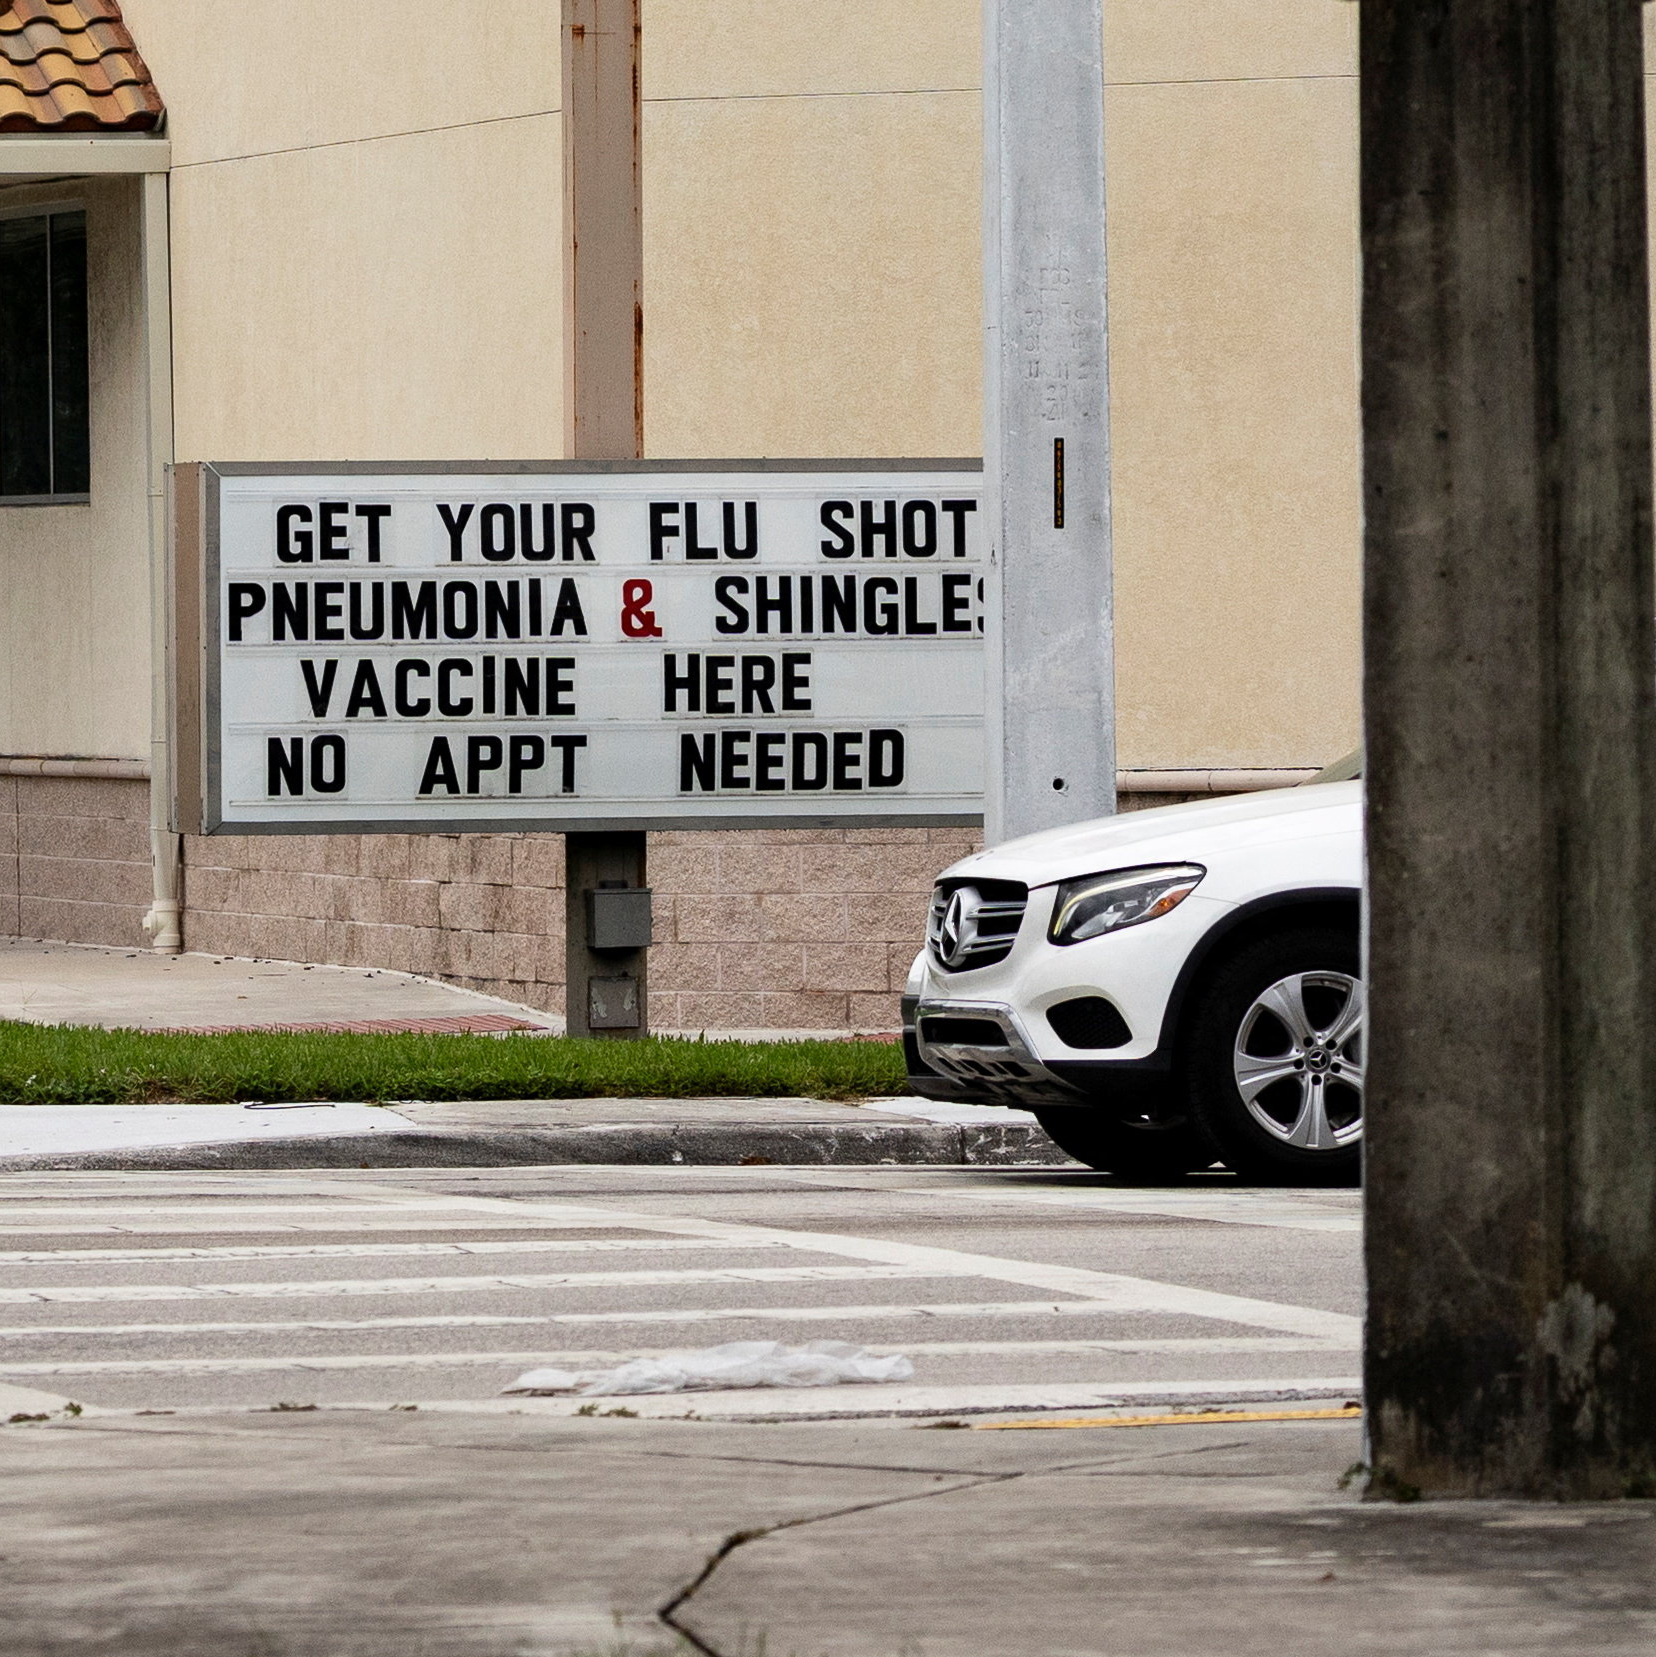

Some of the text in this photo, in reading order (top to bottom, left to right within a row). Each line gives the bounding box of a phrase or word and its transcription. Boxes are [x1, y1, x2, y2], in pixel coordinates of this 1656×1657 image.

[275, 498, 978, 564] GET YOUR FLU SHOT
[227, 577, 589, 643] PNEUMONIA
[620, 578, 664, 639] &
[299, 651, 813, 719] VACCINE HERE
[266, 727, 906, 797] NO APPT NEEDED
